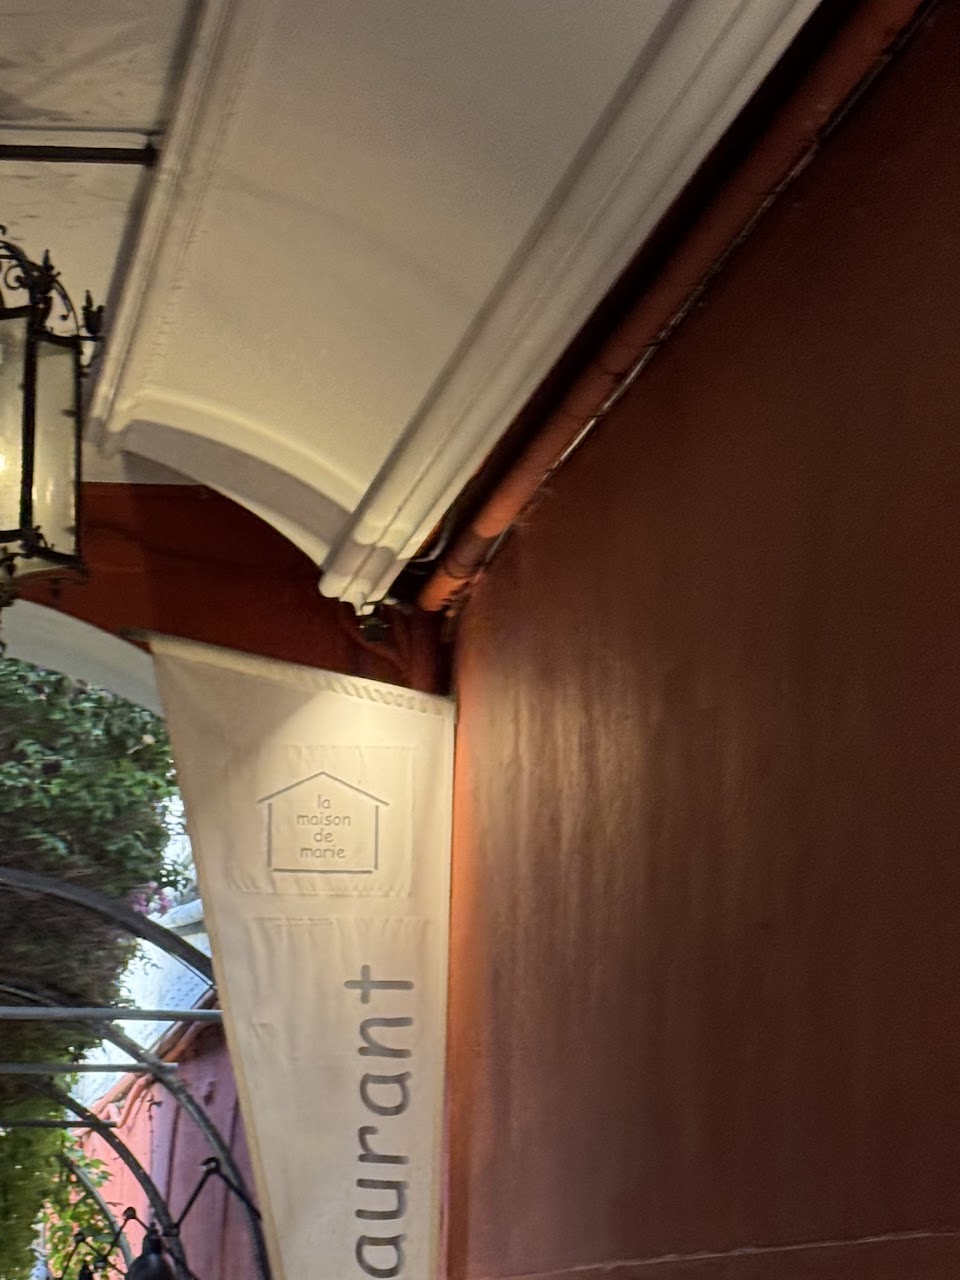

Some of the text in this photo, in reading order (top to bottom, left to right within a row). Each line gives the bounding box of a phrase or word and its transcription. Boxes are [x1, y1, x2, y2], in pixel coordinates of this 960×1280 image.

[317, 794, 331, 809] la
[296, 812, 352, 826] maison
[313, 828, 334, 843] de
[300, 845, 346, 859] marie
